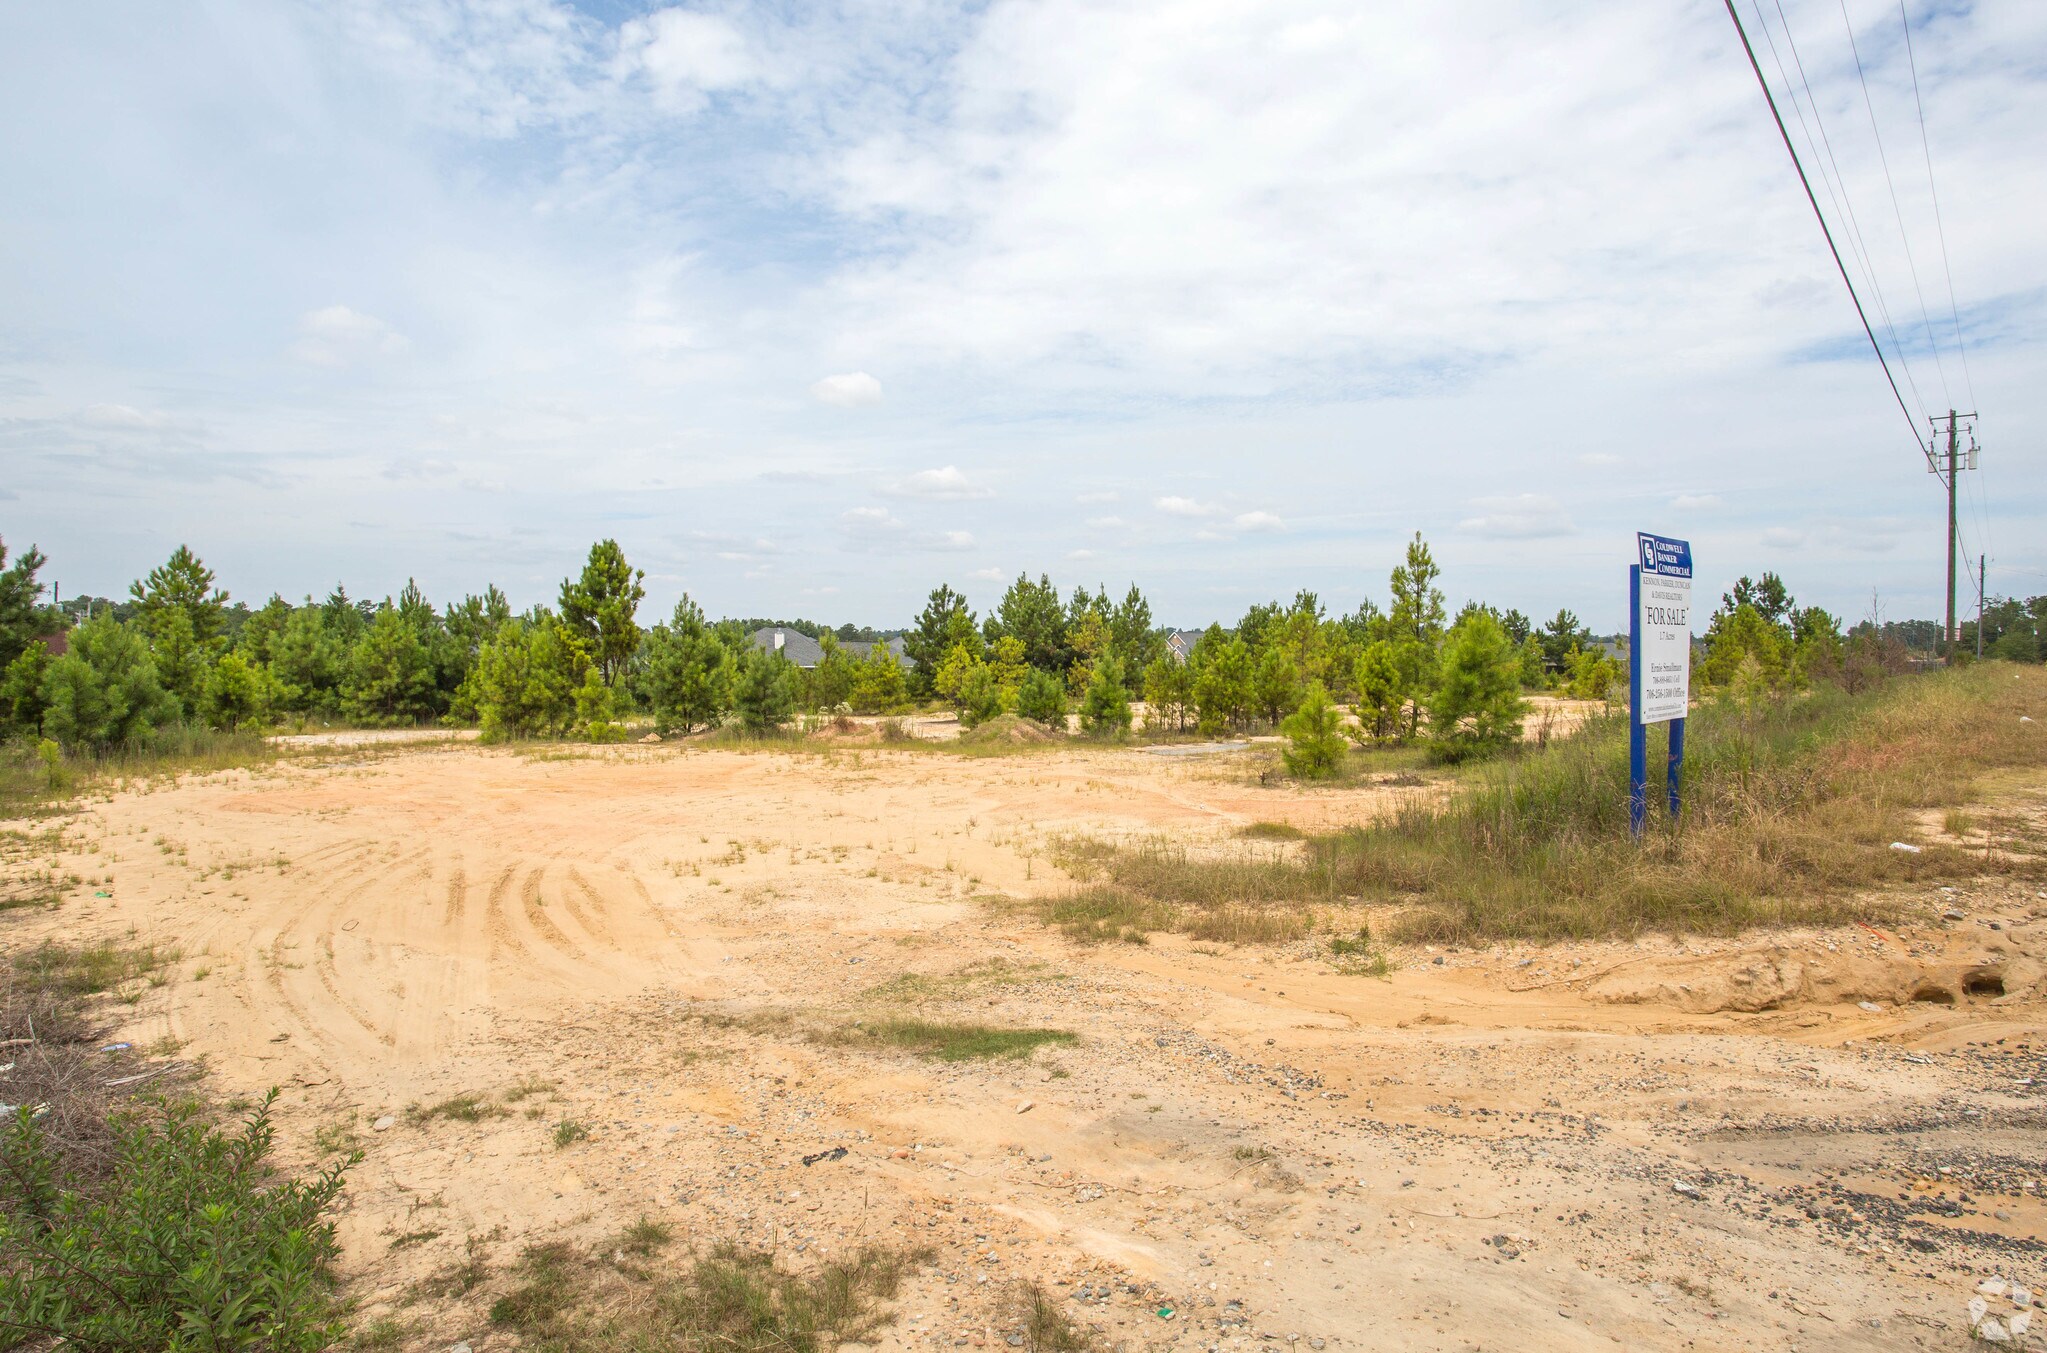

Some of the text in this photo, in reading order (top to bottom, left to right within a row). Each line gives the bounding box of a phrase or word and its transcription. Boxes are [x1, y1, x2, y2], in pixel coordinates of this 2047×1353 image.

[1656, 541, 1684, 554] COLDWELL
[1657, 552, 1678, 564] BANKER
[1658, 563, 1691, 576] COMMERCIAL
[1647, 607, 1686, 626] FOR SALE
